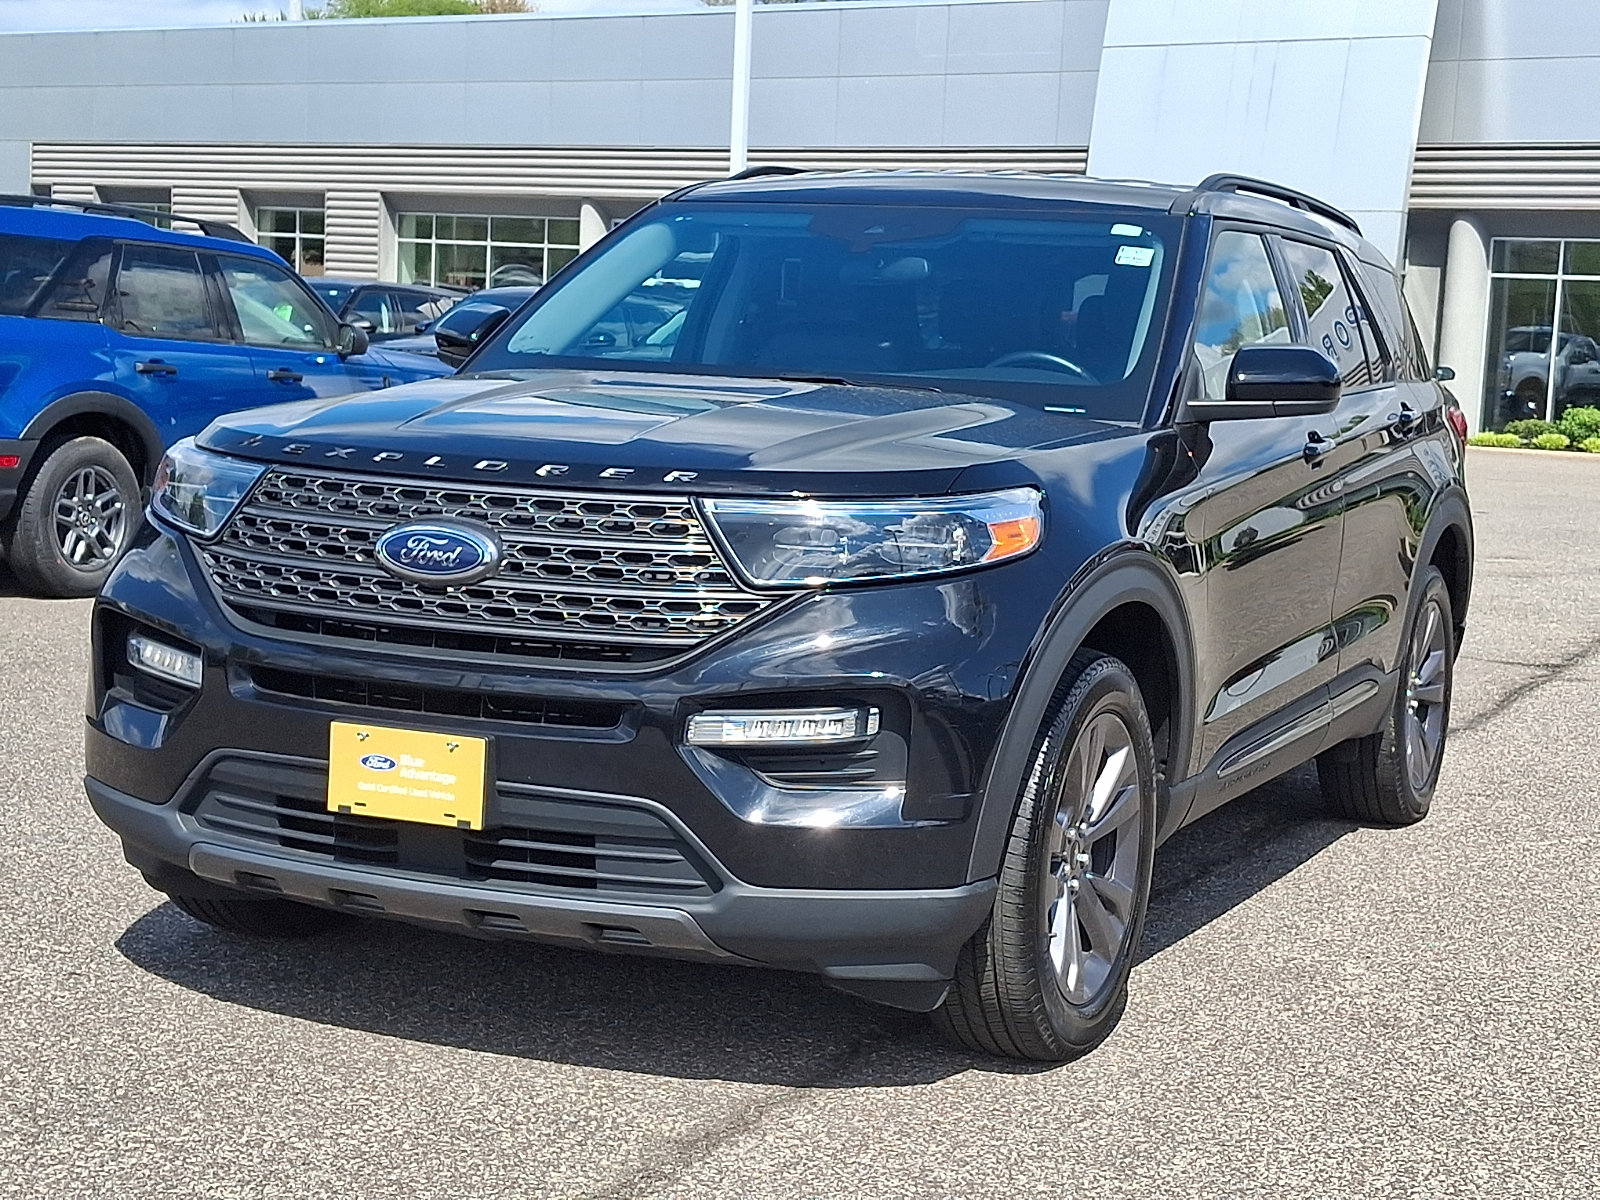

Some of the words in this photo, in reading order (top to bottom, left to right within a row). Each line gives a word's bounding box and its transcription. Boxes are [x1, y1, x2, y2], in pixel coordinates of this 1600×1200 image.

[280, 443, 699, 483] EXPLORER
[400, 535, 463, 567] Ford
[400, 753, 424, 767] Blue
[400, 767, 456, 785] Advantage
[376, 784, 407, 795] Certified
